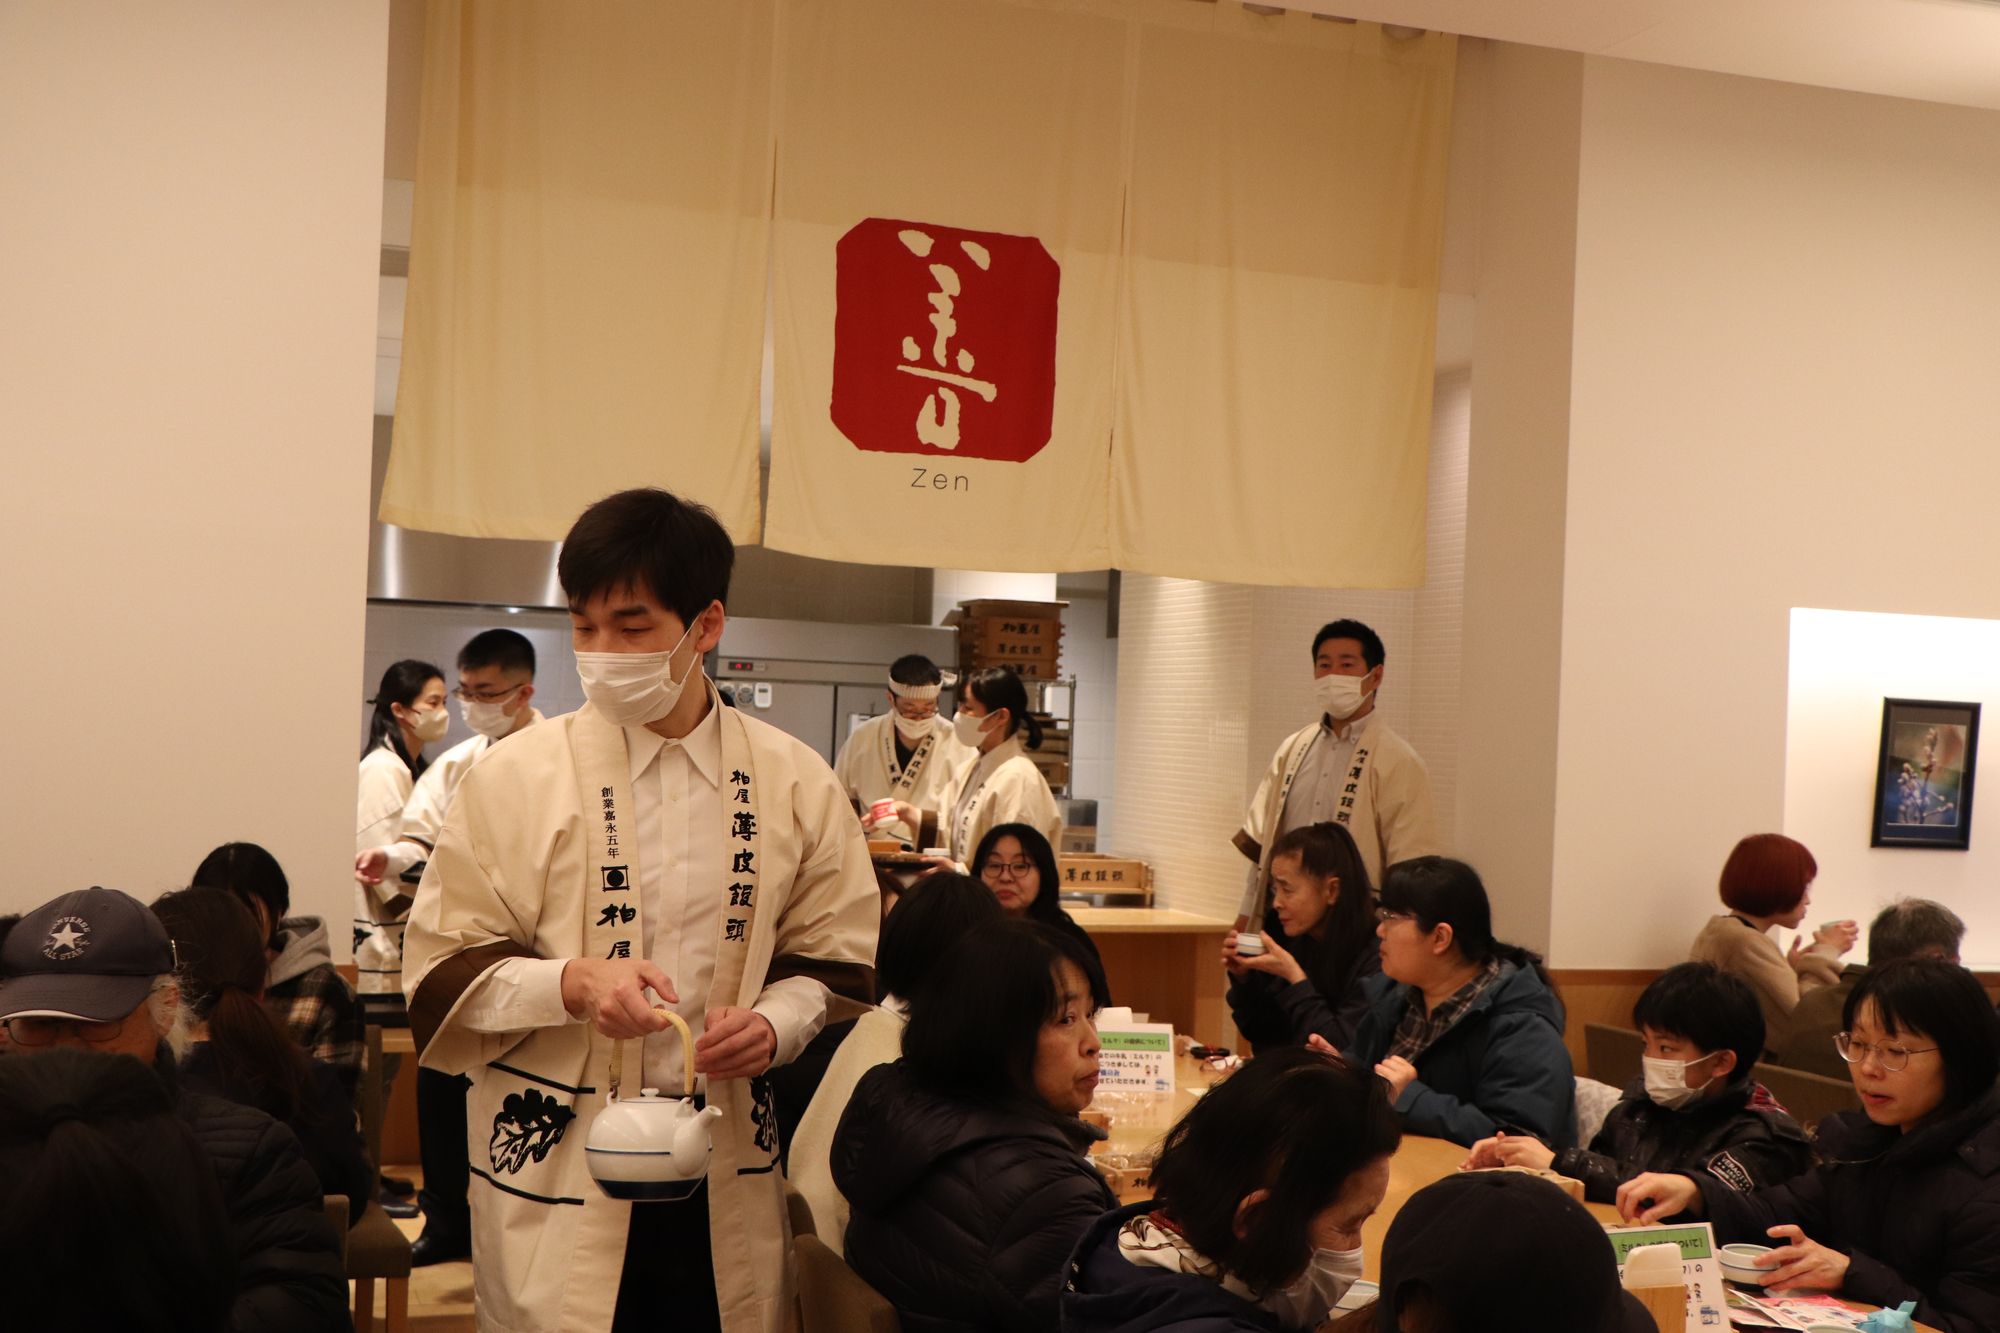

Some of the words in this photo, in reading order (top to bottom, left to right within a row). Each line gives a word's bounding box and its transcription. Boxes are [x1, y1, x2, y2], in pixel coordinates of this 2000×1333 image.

[910, 468, 969, 492] Zen
[600, 786, 620, 860] 創業嘉永五年
[596, 902, 637, 960] 柏屋
